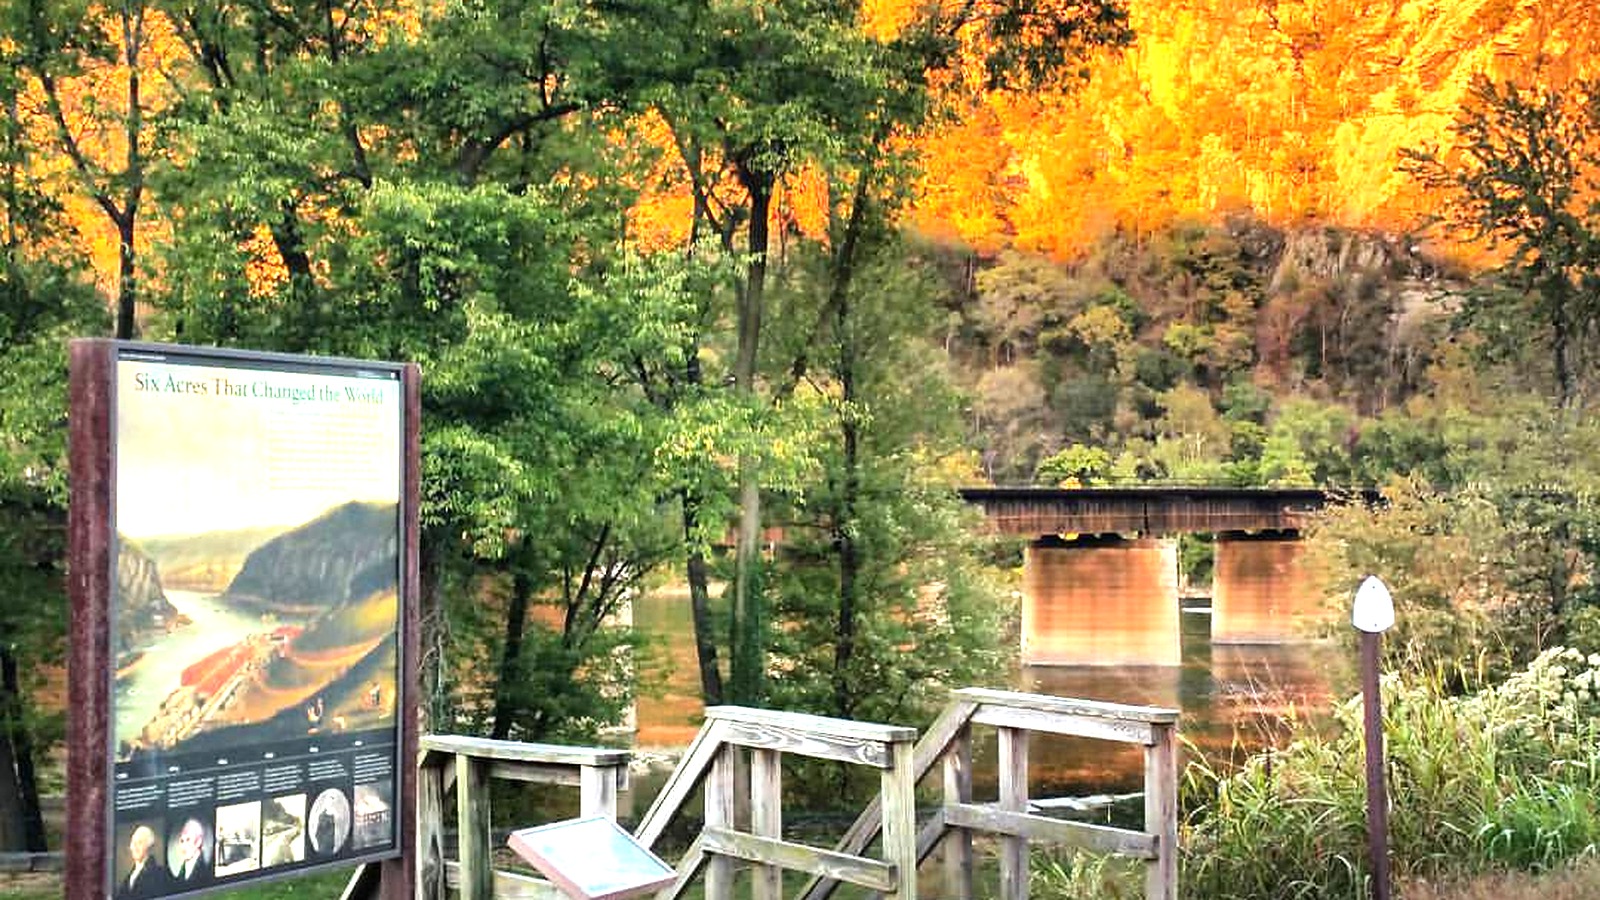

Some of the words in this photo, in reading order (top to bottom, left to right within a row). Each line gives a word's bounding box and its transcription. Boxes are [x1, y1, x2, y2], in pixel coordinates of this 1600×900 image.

[134, 372, 160, 392] Six
[164, 374, 208, 394] Acres
[213, 377, 248, 397] That
[252, 381, 315, 405] Changed
[319, 383, 341, 403] the
[344, 386, 383, 405] World
